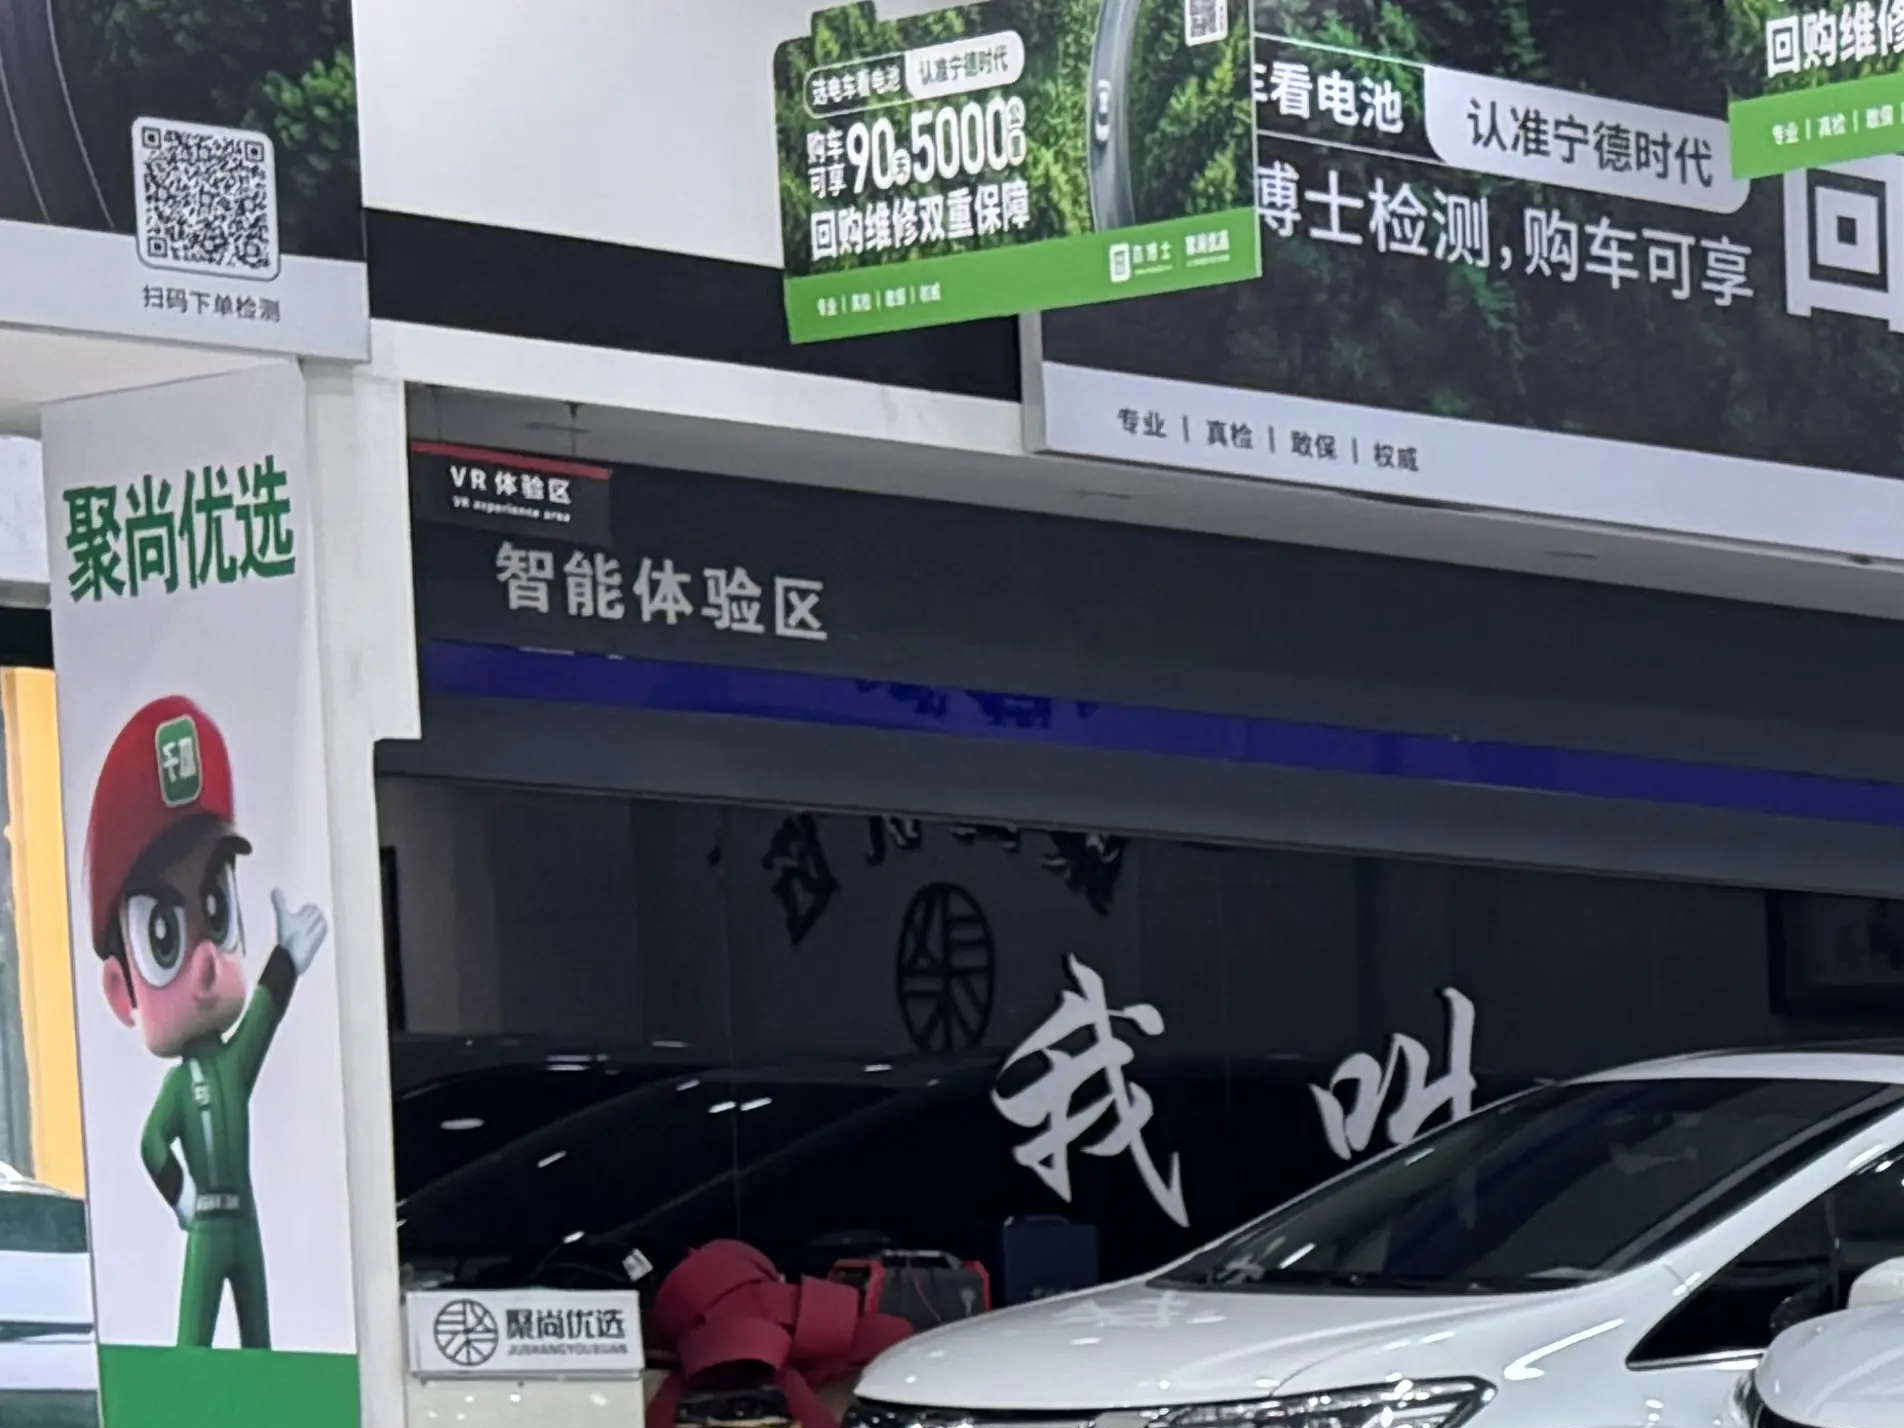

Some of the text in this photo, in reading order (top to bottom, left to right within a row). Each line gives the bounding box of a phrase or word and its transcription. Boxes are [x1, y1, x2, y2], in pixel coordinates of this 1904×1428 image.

[1467, 99, 1713, 188] 认准宁德时代
[811, 178, 1030, 262] 回购维修双重保障
[142, 284, 281, 323] 扫码下单检测
[1117, 406, 1166, 439] 专业
[449, 464, 572, 505] VR 体验区
[63, 454, 297, 604] 聚尚优选
[495, 540, 829, 641] 智能体验区
[991, 951, 1190, 1228] 我
[506, 1308, 626, 1340] 聚尚优选
